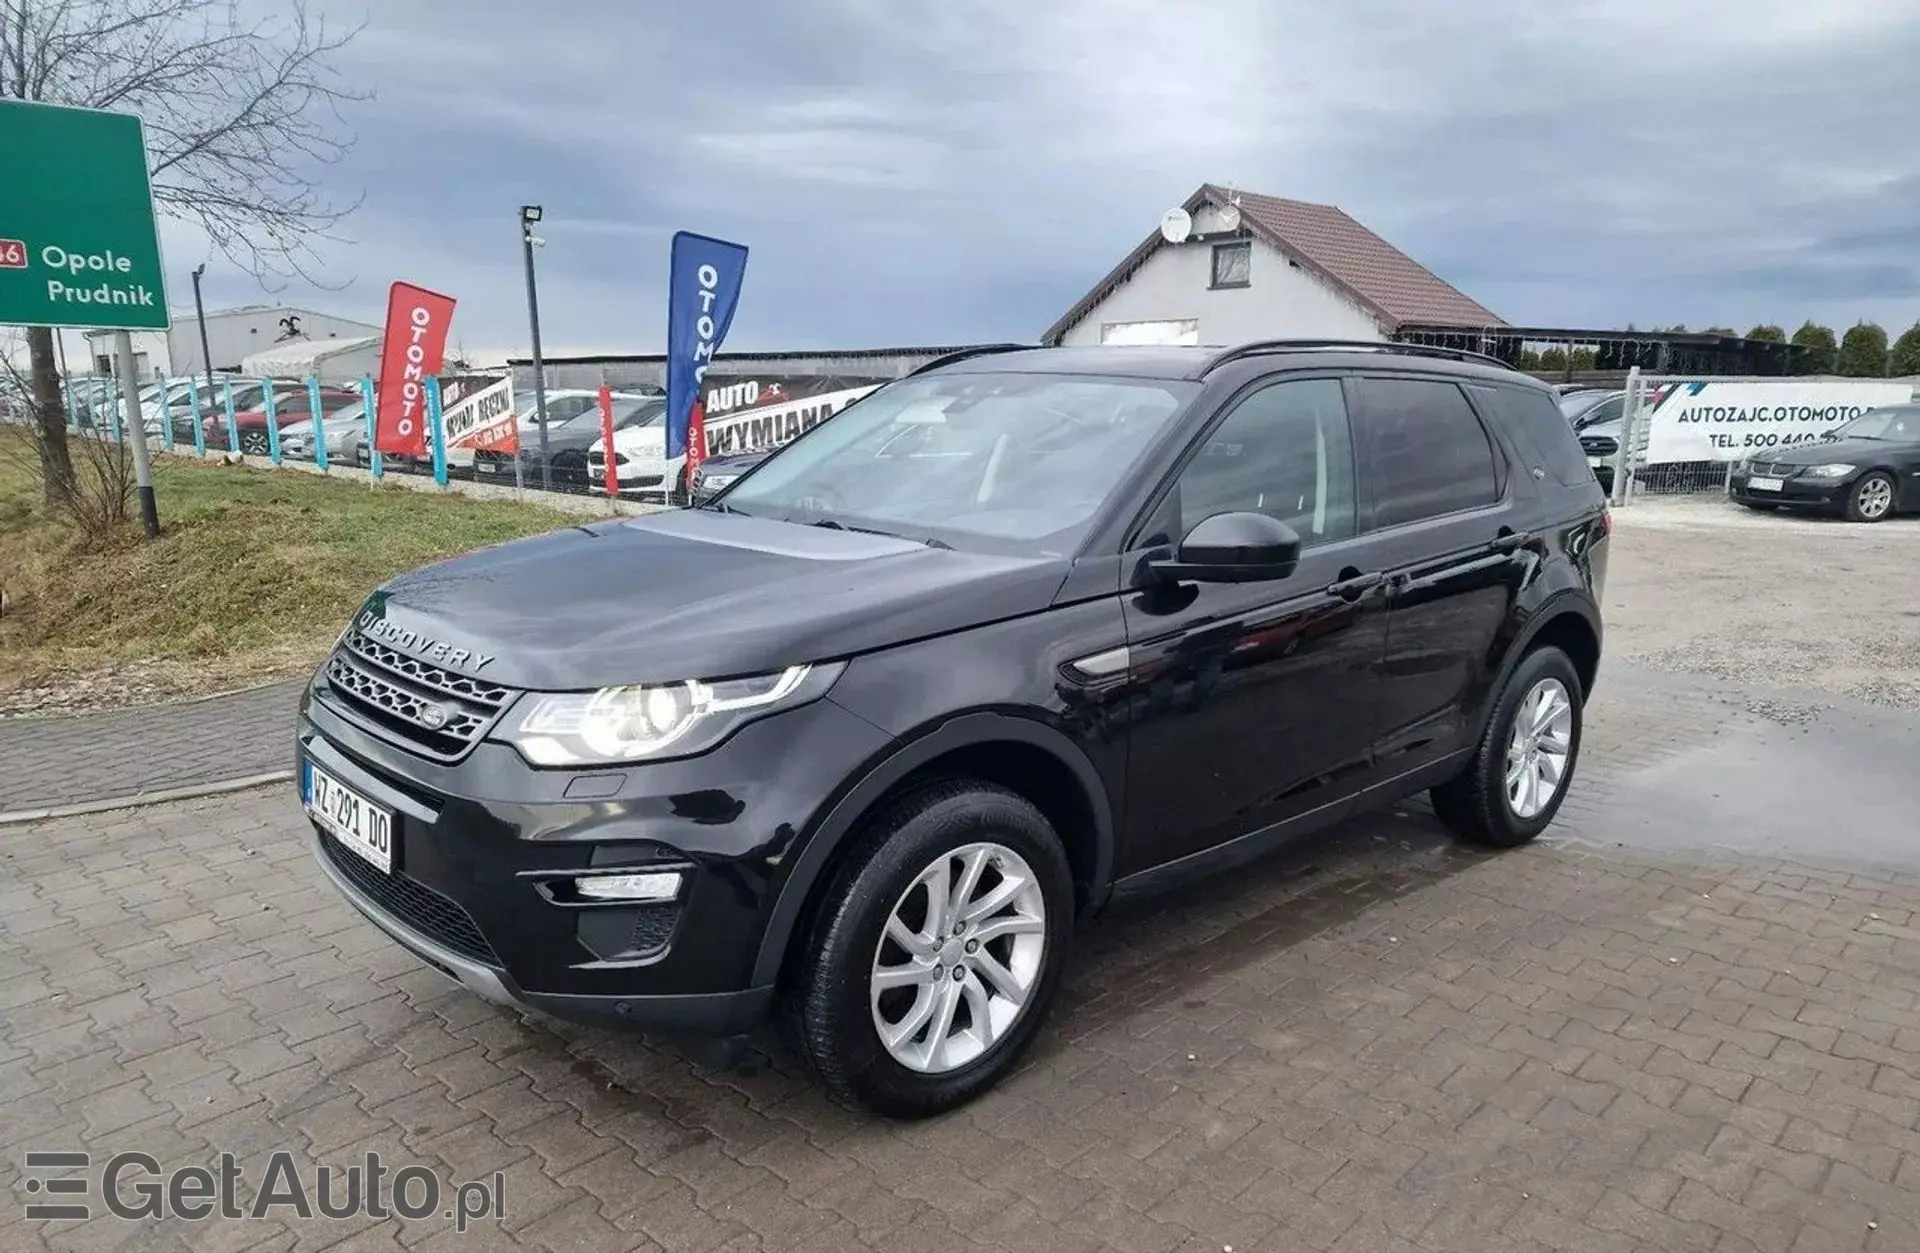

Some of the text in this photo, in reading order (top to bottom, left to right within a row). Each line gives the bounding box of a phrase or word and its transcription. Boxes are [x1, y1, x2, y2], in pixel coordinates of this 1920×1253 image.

[41, 246, 131, 275] Opole
[47, 280, 154, 305] Prudnik
[398, 307, 430, 436] OTOMOTO
[706, 381, 759, 414] AUTO
[1709, 434, 1739, 448] TEL.
[1743, 433, 1777, 447] 500
[360, 610, 496, 673] DISCOVERY
[337, 787, 360, 837] 291
